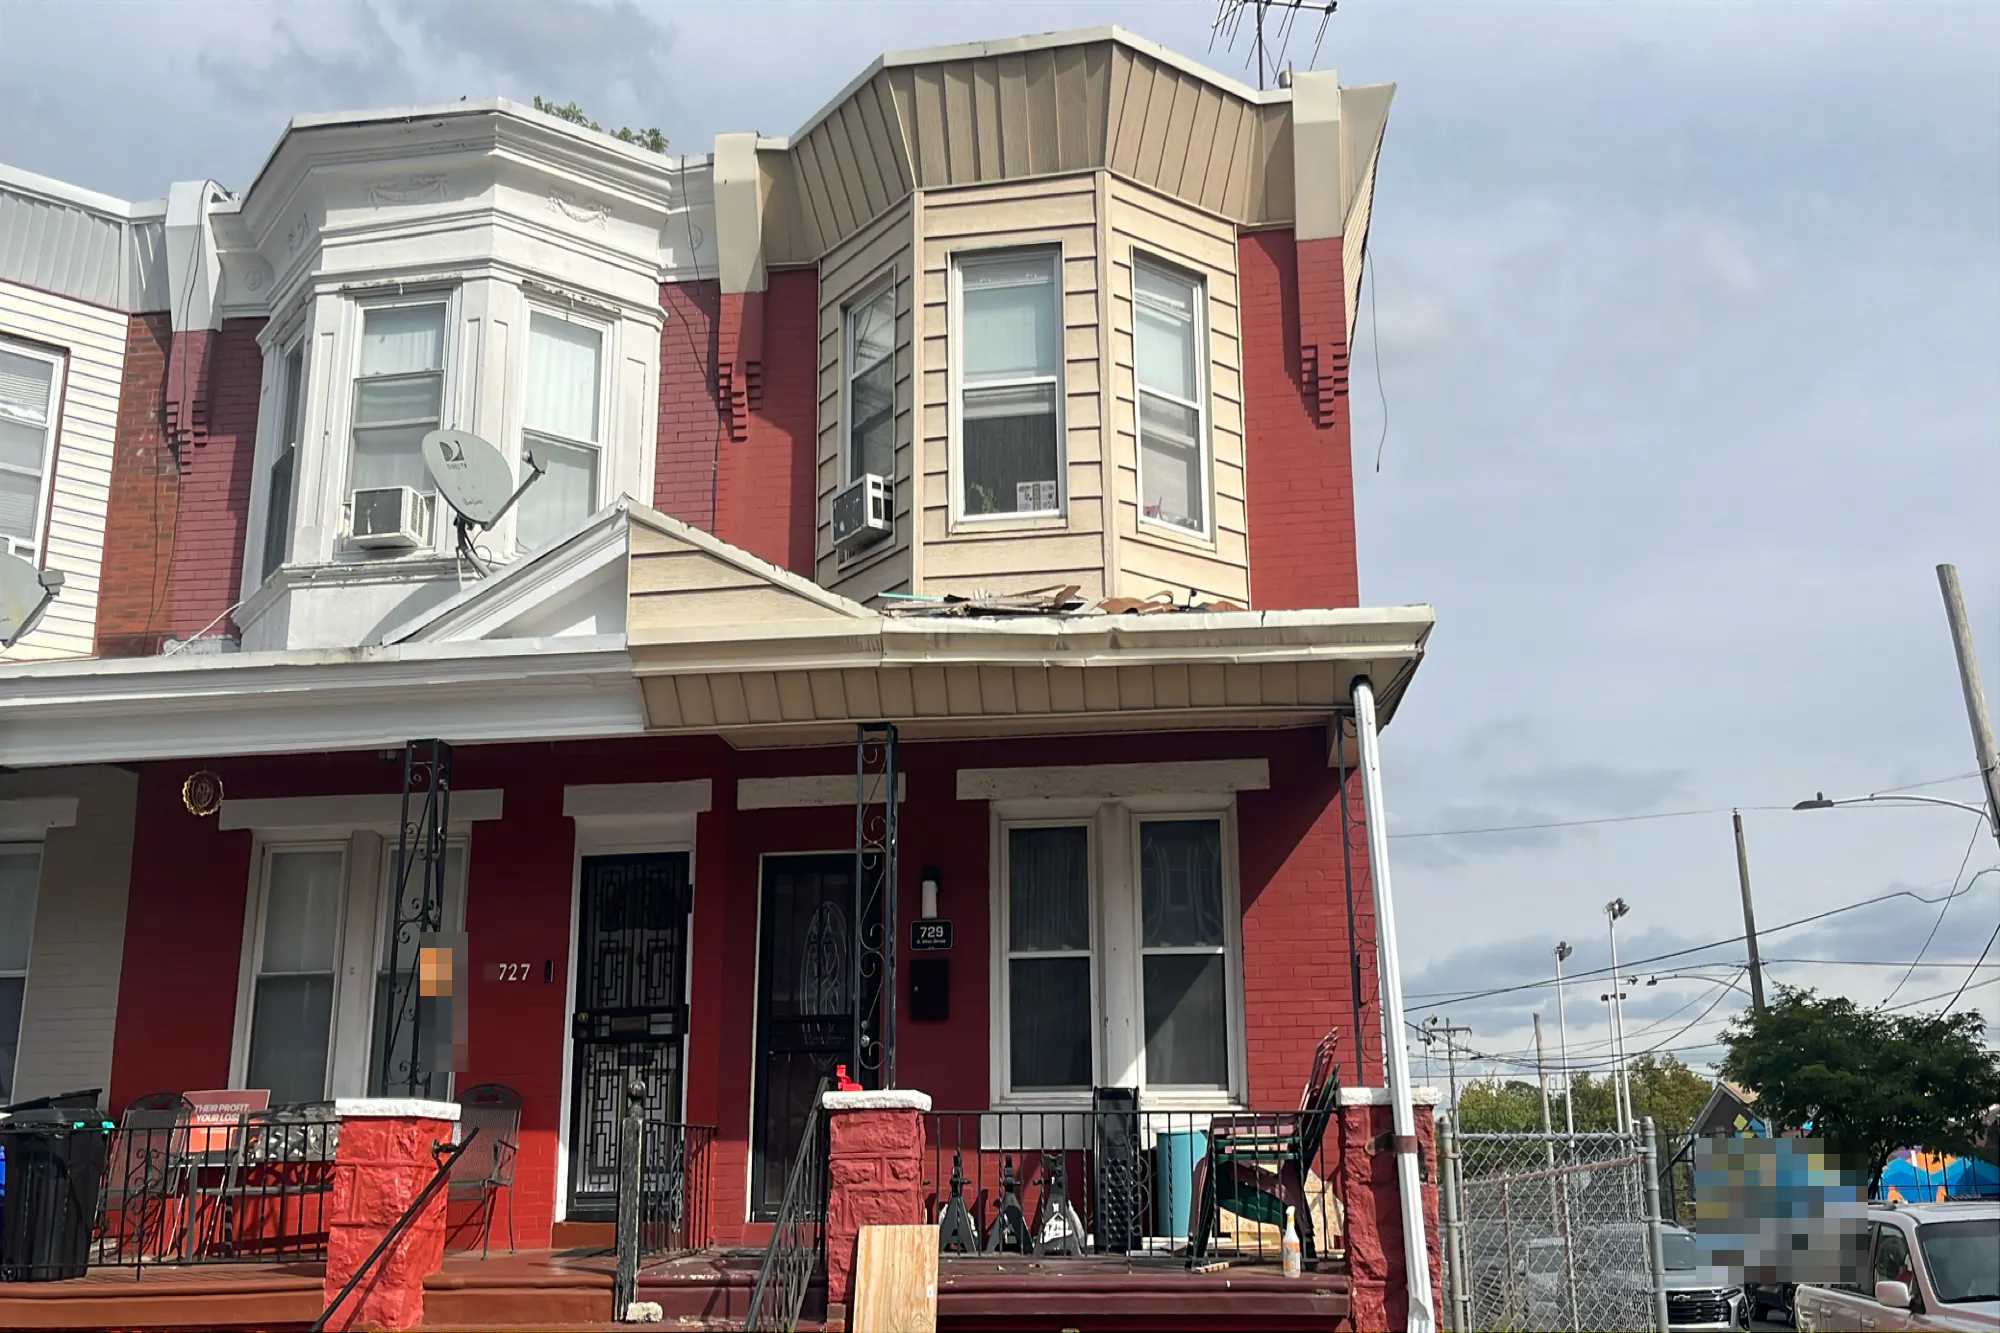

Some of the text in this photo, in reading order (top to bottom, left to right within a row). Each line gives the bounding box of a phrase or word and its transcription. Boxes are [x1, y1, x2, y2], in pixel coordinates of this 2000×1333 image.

[920, 926, 944, 938] 729
[500, 963, 531, 981] 727
[194, 1104, 219, 1112] THEIR
[196, 1113, 240, 1123] YOUR LOS
